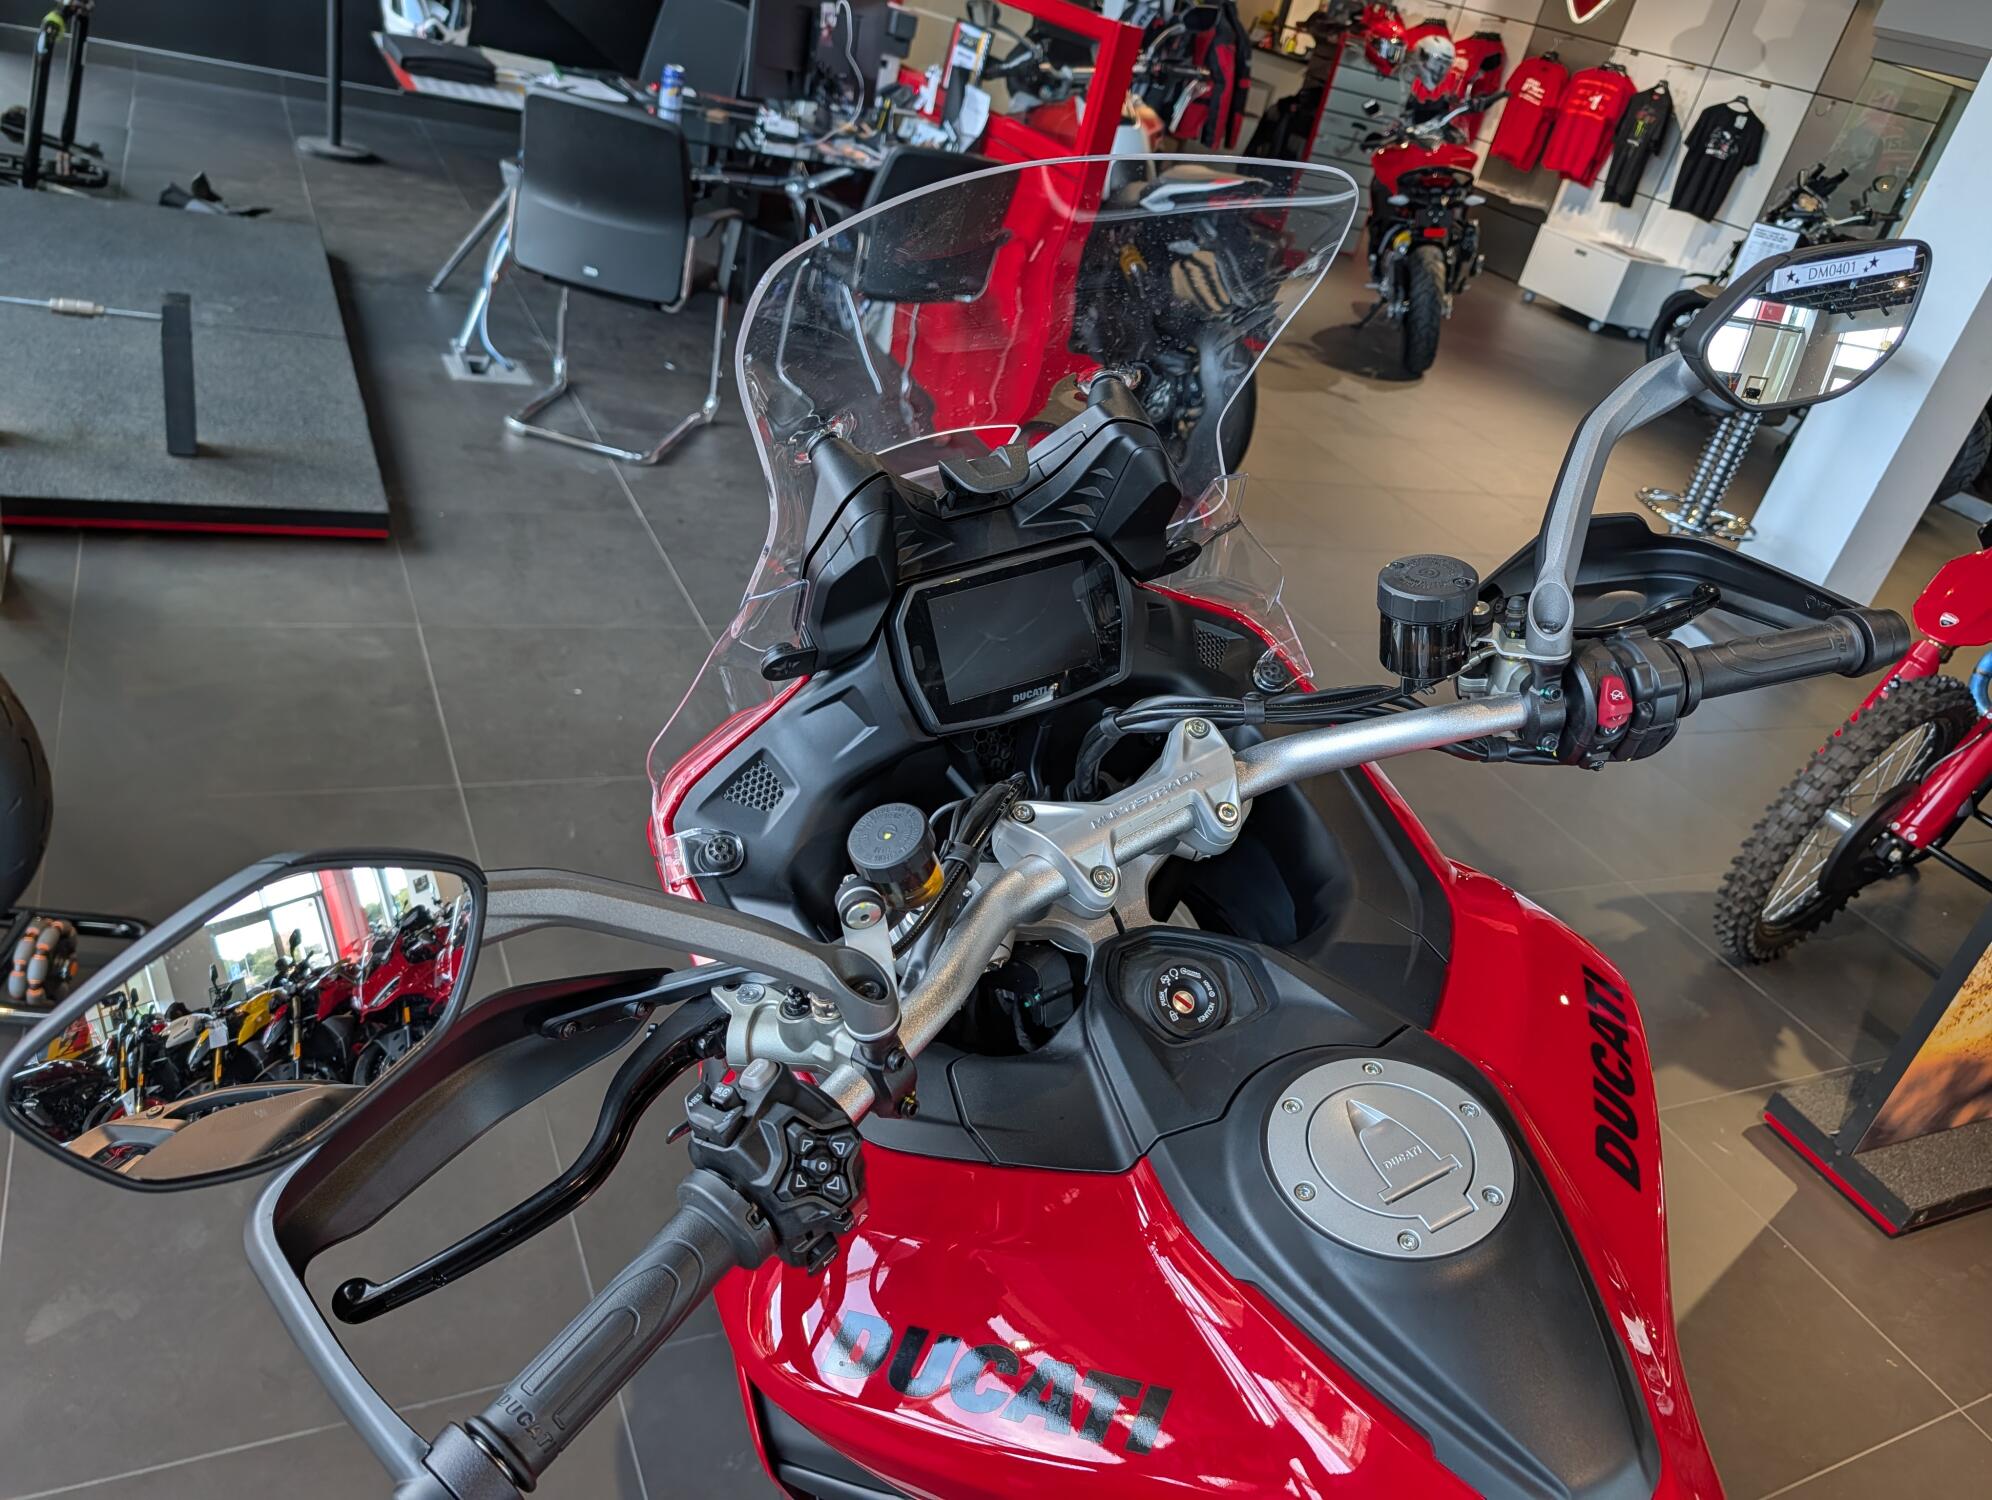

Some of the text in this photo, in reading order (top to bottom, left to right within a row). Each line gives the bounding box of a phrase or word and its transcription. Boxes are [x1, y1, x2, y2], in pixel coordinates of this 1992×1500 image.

[1808, 261, 1857, 281] DM0401
[1012, 685, 1048, 703] DUCATI
[1197, 1002, 1215, 1023] IGNITION
[1582, 964, 1642, 1193] DUCATI
[1382, 1144, 1422, 1169] DUCATI
[820, 1309, 1174, 1455] DUCATI
[496, 1393, 557, 1454] DUCATI
